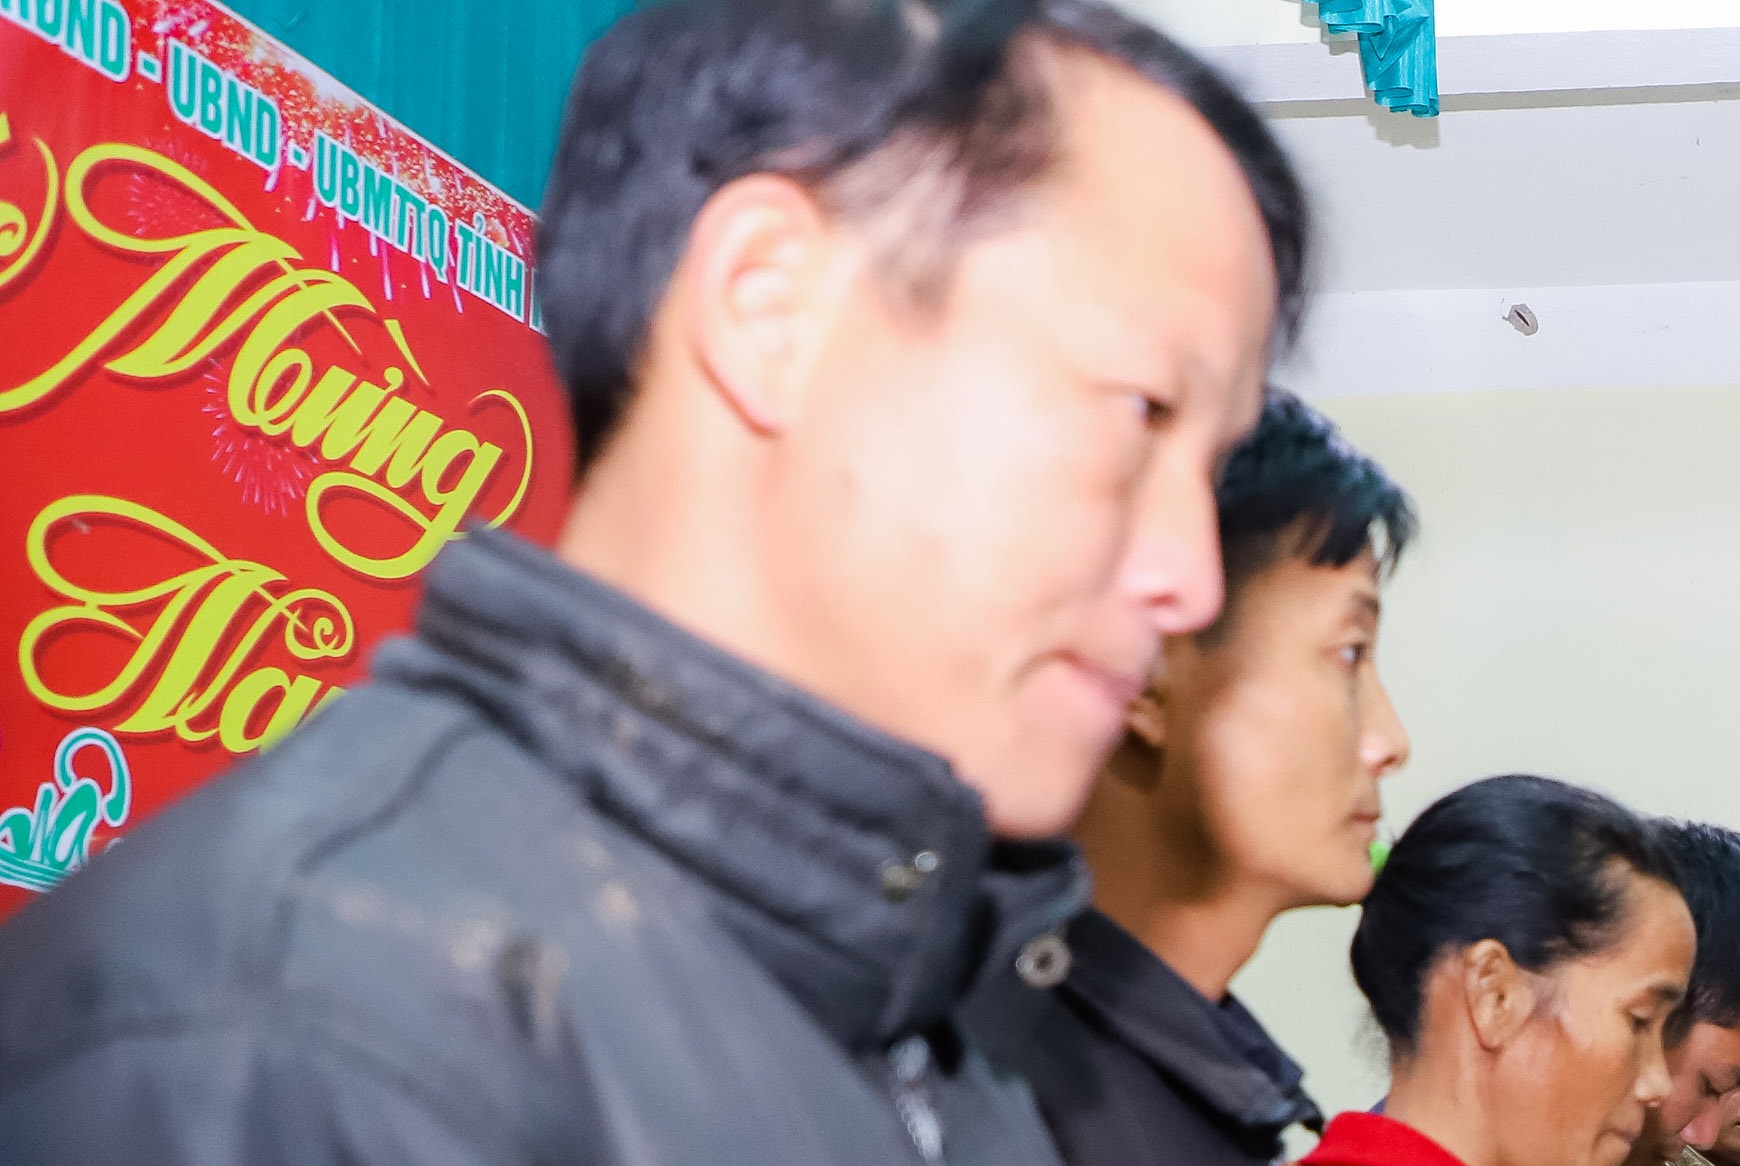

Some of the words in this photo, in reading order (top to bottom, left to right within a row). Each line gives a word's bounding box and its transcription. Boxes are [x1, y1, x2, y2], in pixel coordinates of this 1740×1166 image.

[0, 0, 130, 80] ND
[168, 38, 281, 168] UBND
[314, 128, 449, 284] UBMTTQ
[456, 212, 525, 324] TỈNH
